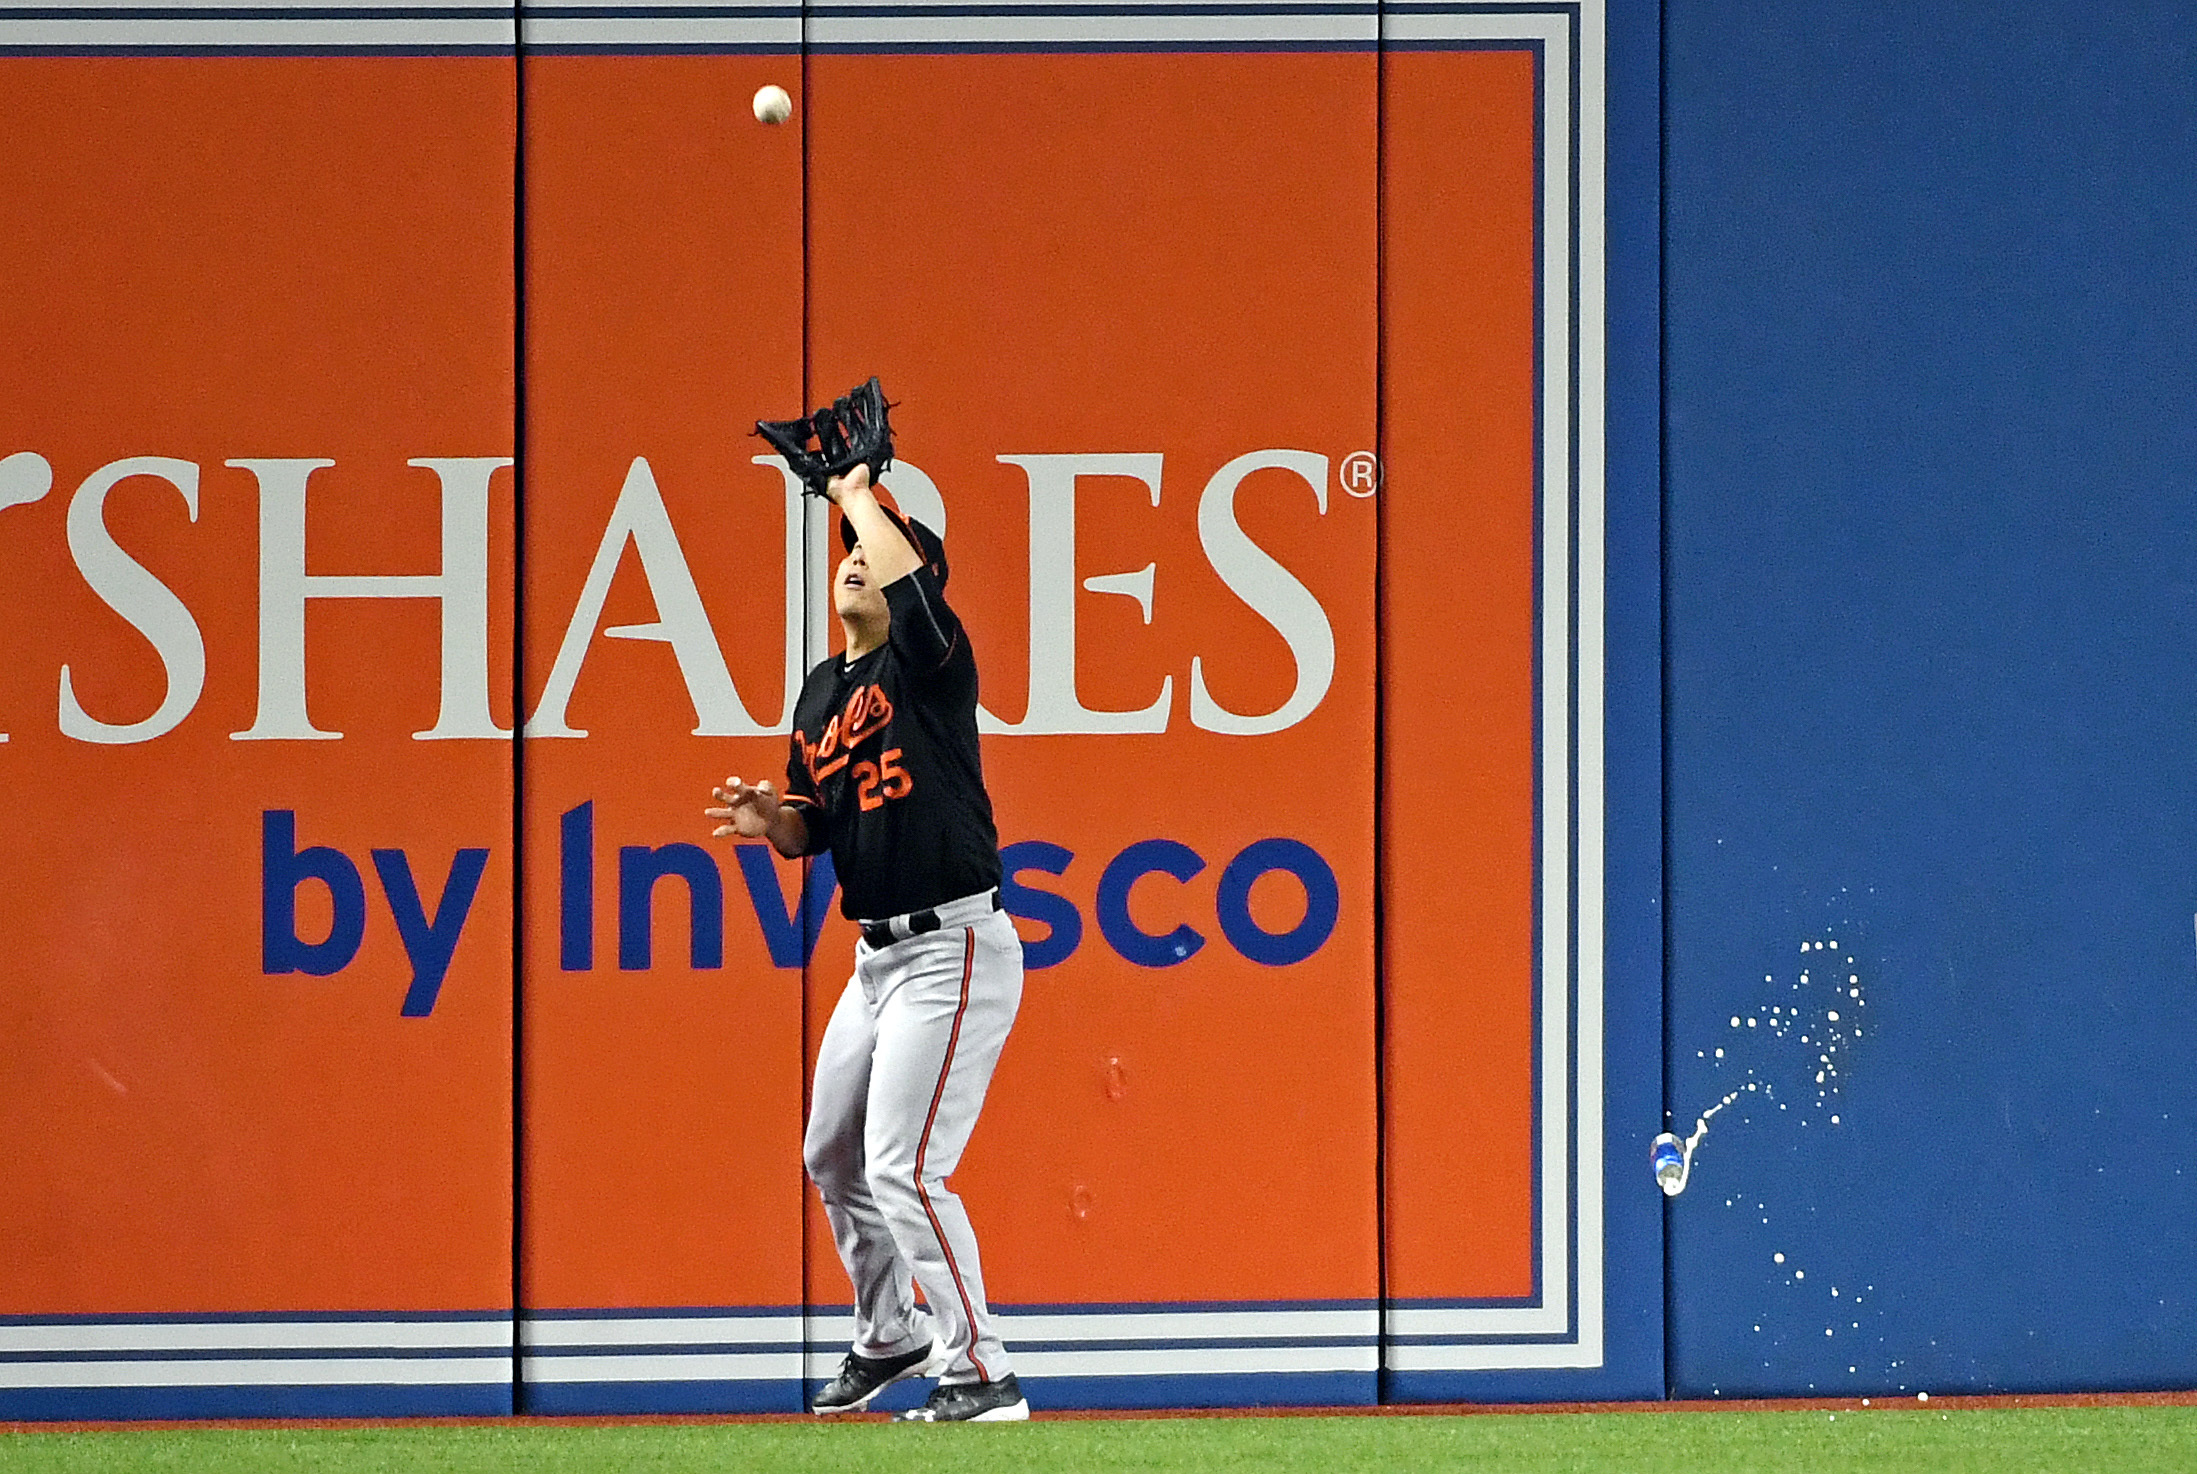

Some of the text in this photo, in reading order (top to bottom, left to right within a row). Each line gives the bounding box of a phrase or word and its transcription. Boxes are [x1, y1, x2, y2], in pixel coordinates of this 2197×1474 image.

[0, 448, 1335, 744] SHARES
[852, 747, 914, 812] 25
[262, 799, 1340, 1018] by Invsco
